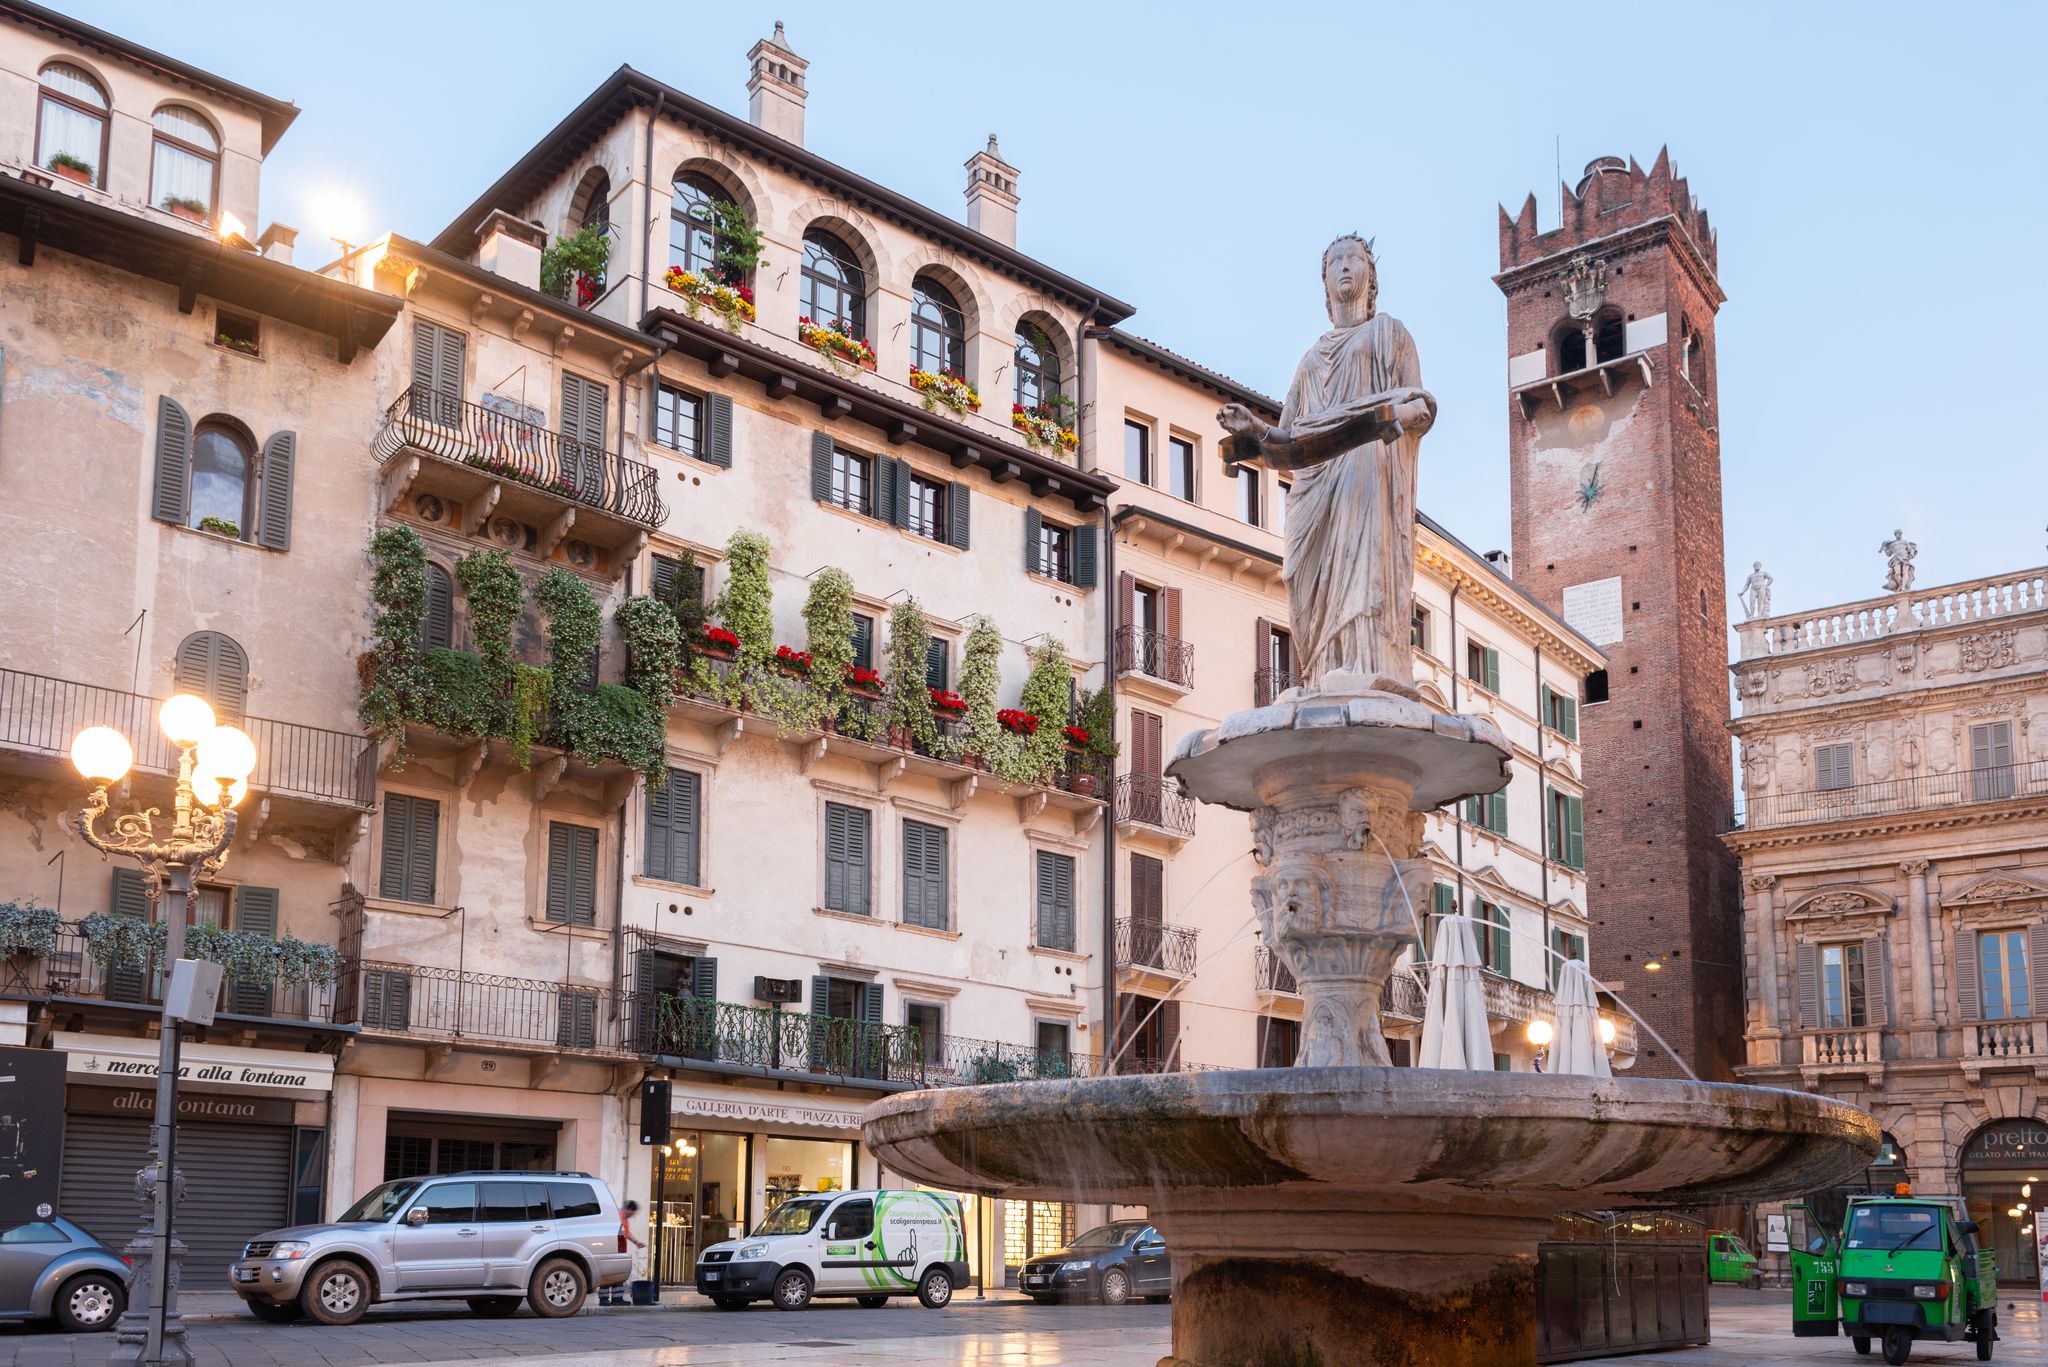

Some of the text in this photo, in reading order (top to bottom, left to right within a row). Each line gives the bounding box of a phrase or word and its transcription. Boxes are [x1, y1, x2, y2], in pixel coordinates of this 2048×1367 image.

[107, 1061, 306, 1086] mercea alla fontana
[113, 1092, 255, 1116] alla ontana
[687, 1100, 743, 1115] GALLERIA
[749, 1106, 789, 1119] D'ARTE
[890, 1218, 943, 1226] scaligeraimpresa.it
